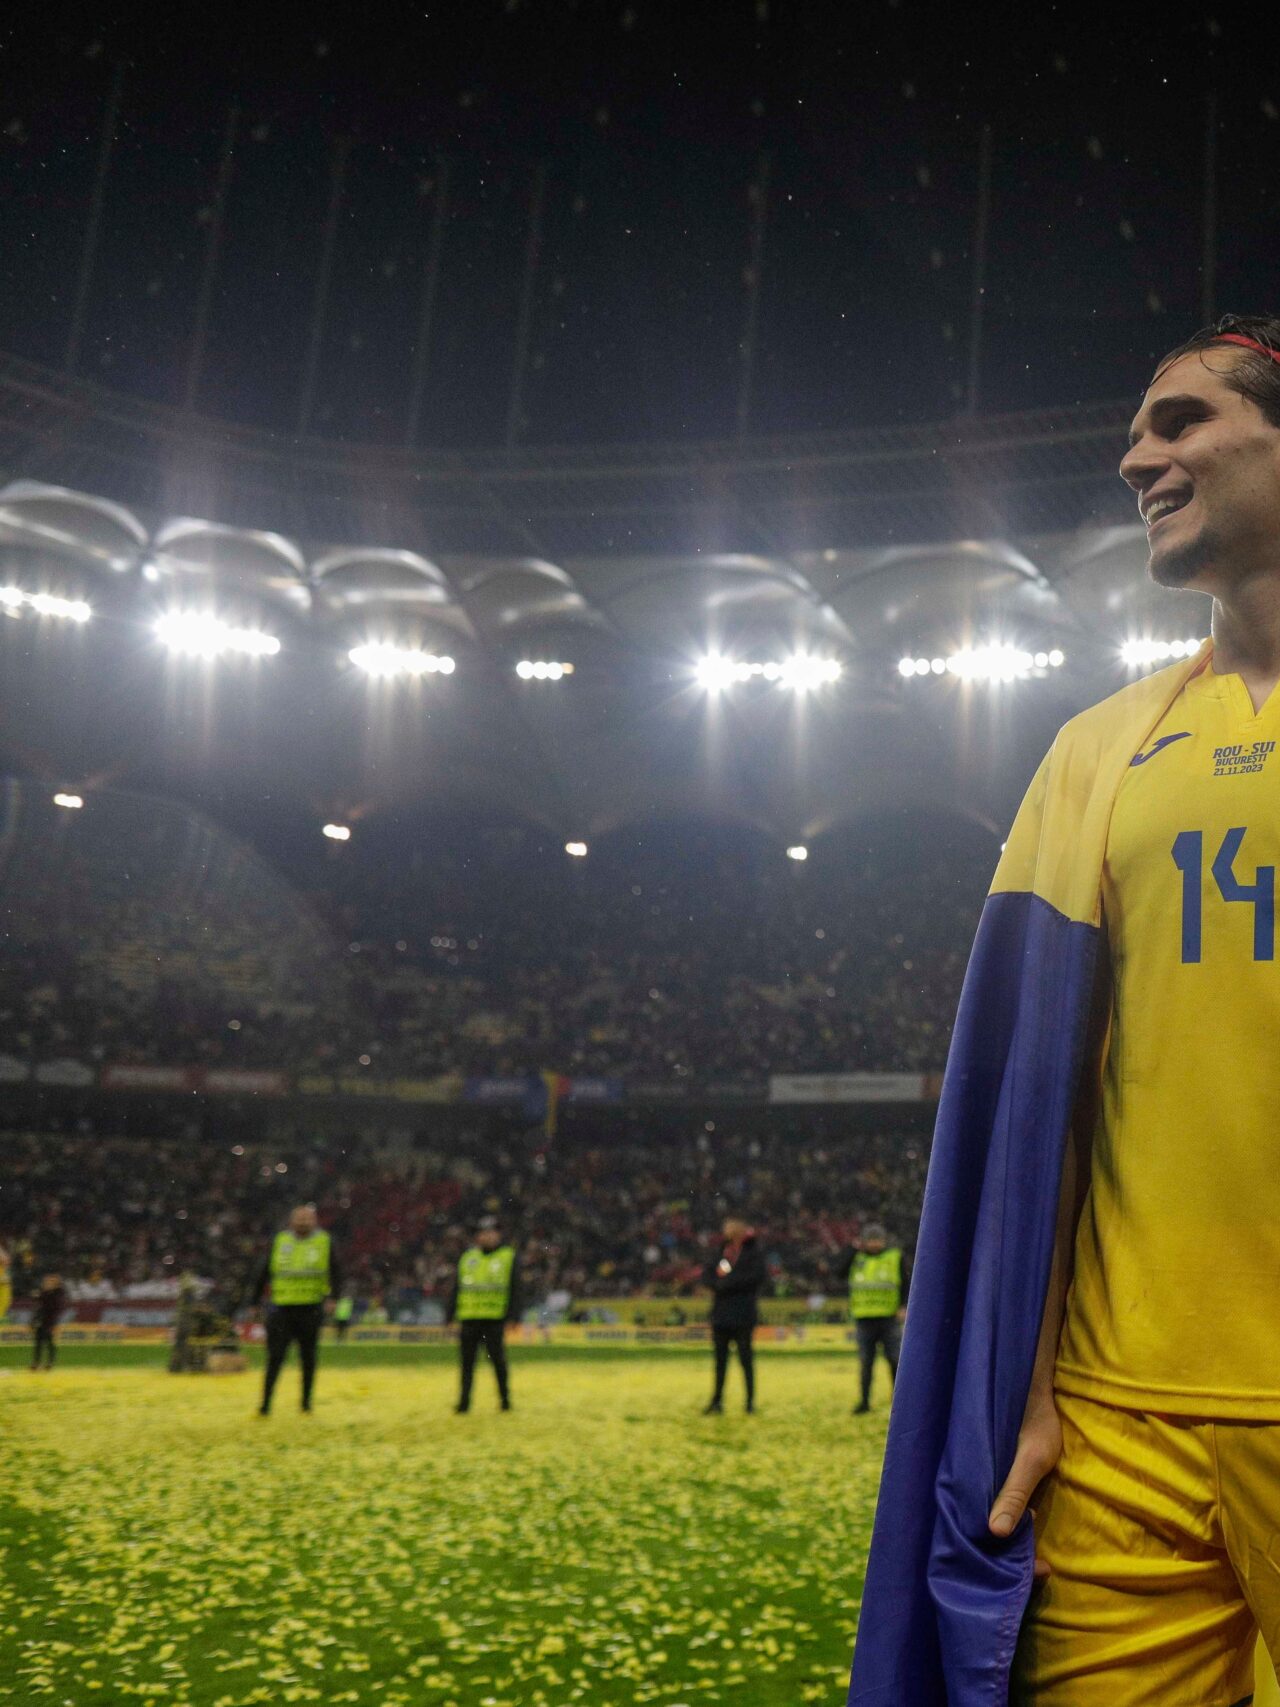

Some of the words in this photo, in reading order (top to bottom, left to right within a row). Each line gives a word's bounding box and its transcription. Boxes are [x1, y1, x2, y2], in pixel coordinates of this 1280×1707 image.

[1213, 745, 1243, 759] ROU
[1251, 741, 1276, 754] SUI
[1213, 764, 1263, 776] 21.11.2023
[1171, 827, 1275, 964] 14
